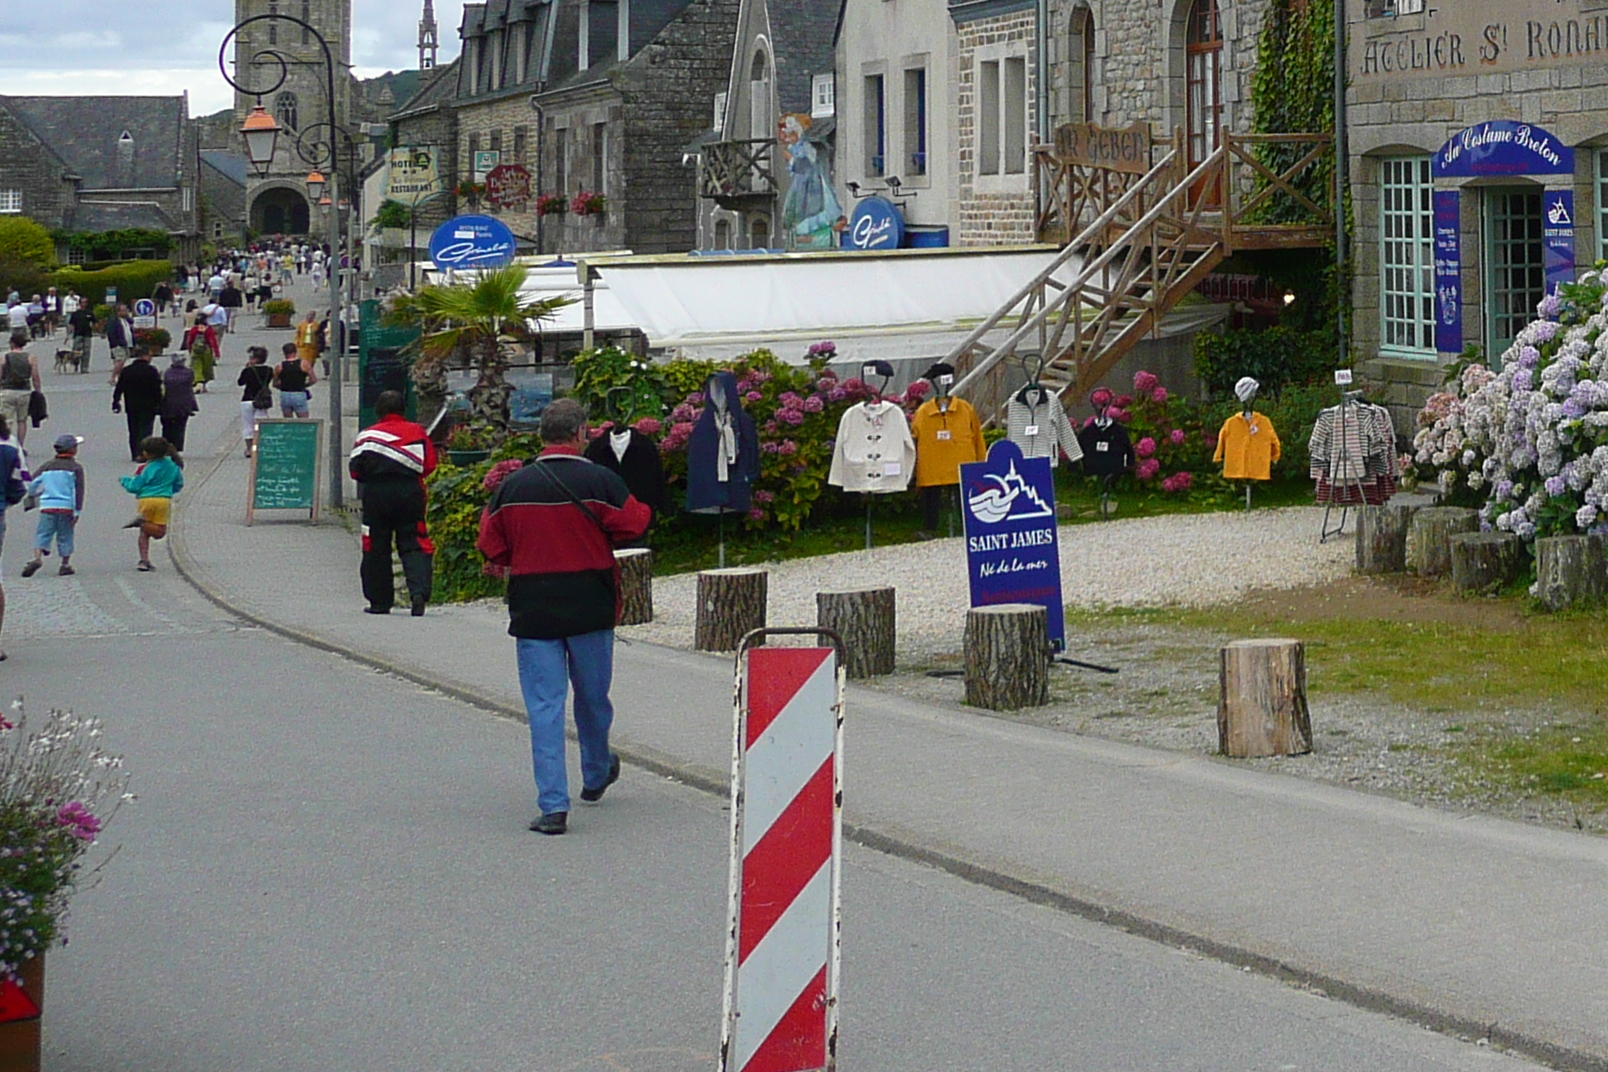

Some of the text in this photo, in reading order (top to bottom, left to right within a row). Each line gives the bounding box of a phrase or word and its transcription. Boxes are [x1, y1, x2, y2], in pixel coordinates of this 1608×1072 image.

[1461, 123, 1512, 150] Costume
[1514, 124, 1562, 166] Breton
[969, 528, 1053, 553] SAINT JAMES
[996, 559, 1010, 574] de
[1011, 557, 1025, 572] la
